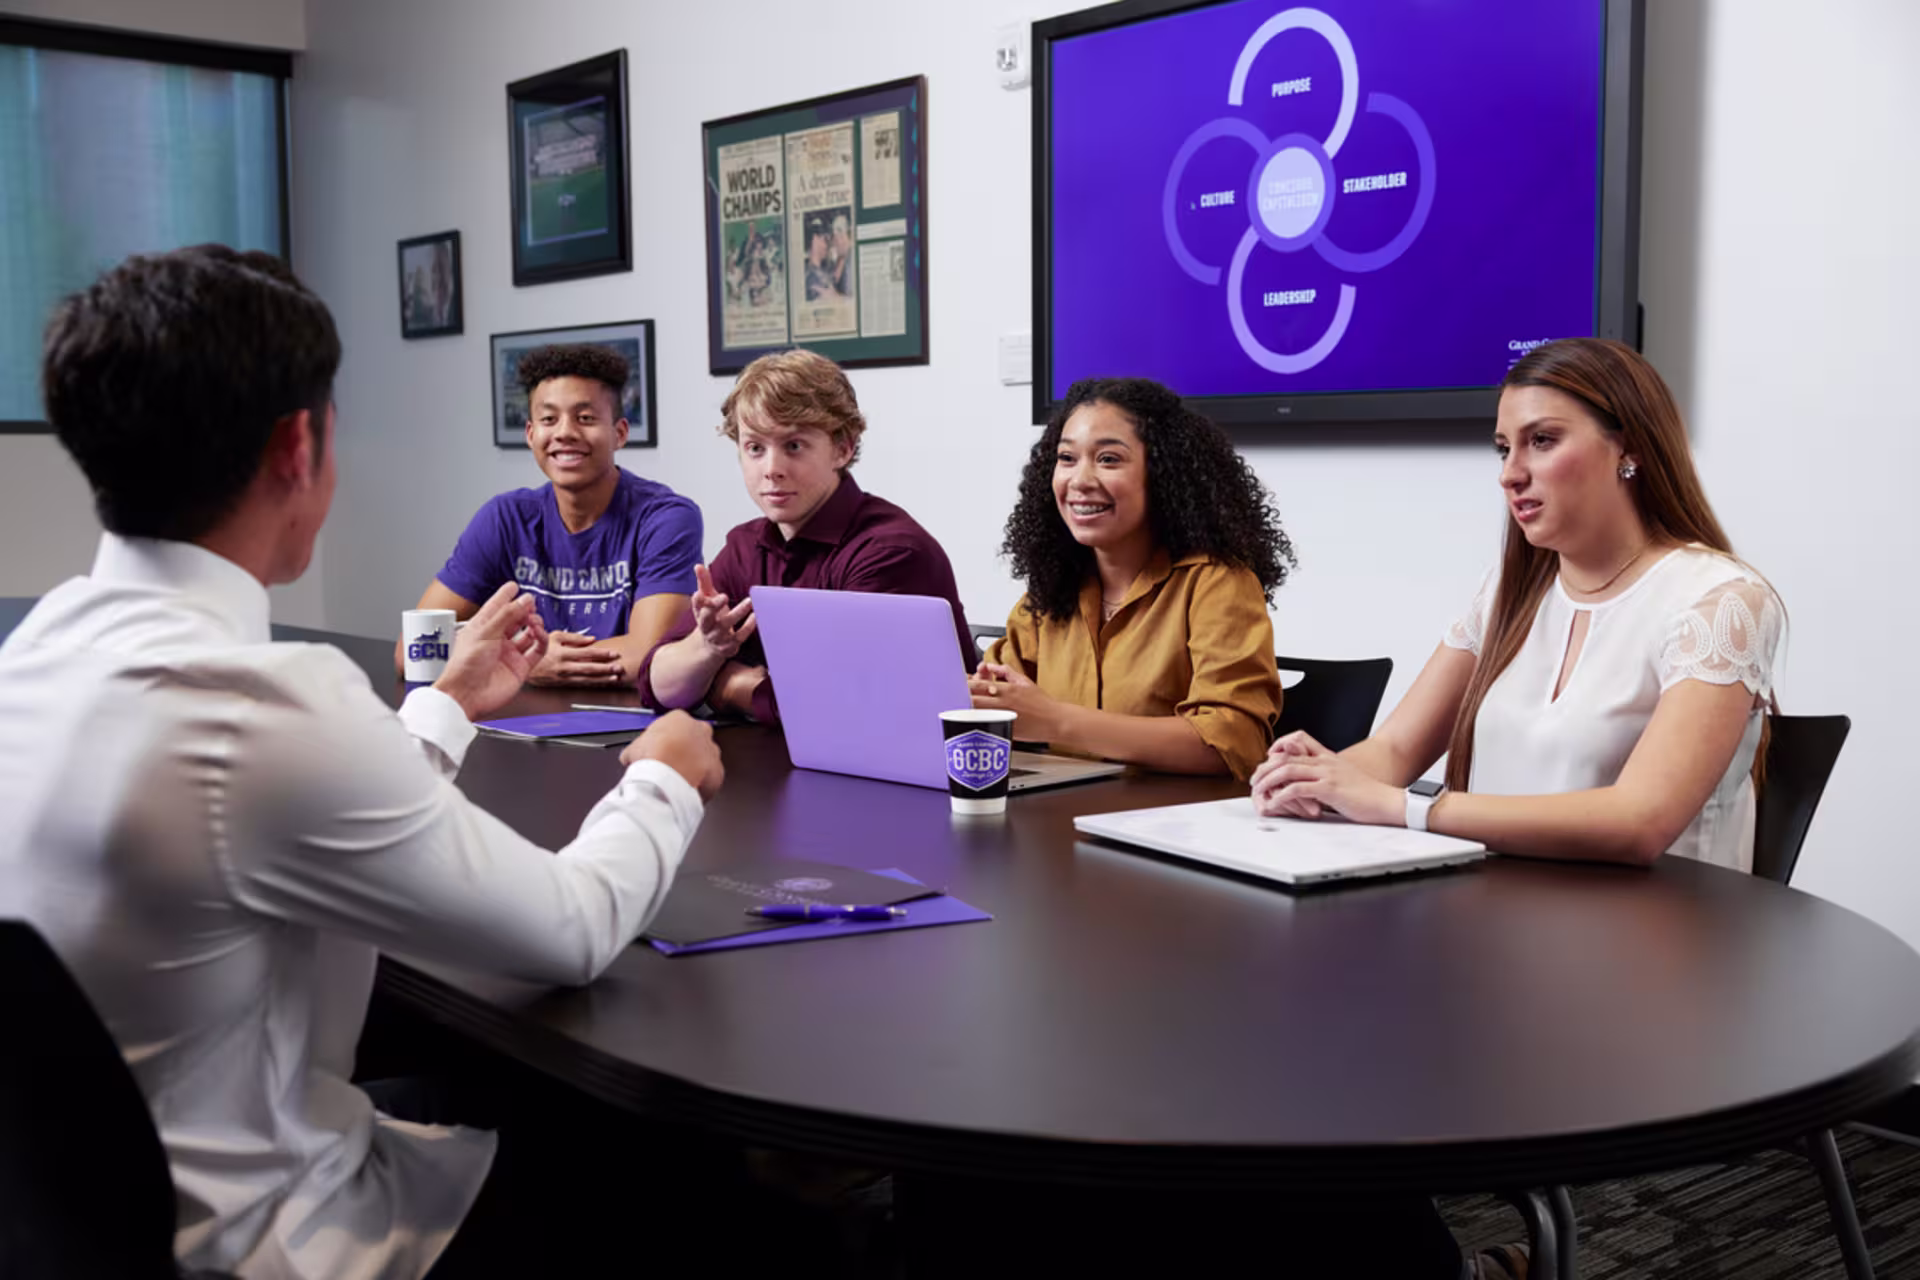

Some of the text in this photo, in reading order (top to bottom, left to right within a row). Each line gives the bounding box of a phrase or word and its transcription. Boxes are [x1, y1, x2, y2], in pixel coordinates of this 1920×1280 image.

[1271, 77, 1312, 98] PURPOSE
[726, 165, 776, 193] WORLD
[809, 172, 845, 190] dream
[1342, 171, 1407, 194] STAKEHOLDER
[723, 189, 781, 219] CHAMPS
[1200, 190, 1235, 207] CULTURE
[1263, 289, 1316, 307] LEADERSHIP
[514, 555, 575, 592] GRAND
[408, 642, 449, 662] GCU
[952, 748, 1005, 772] GCBC
